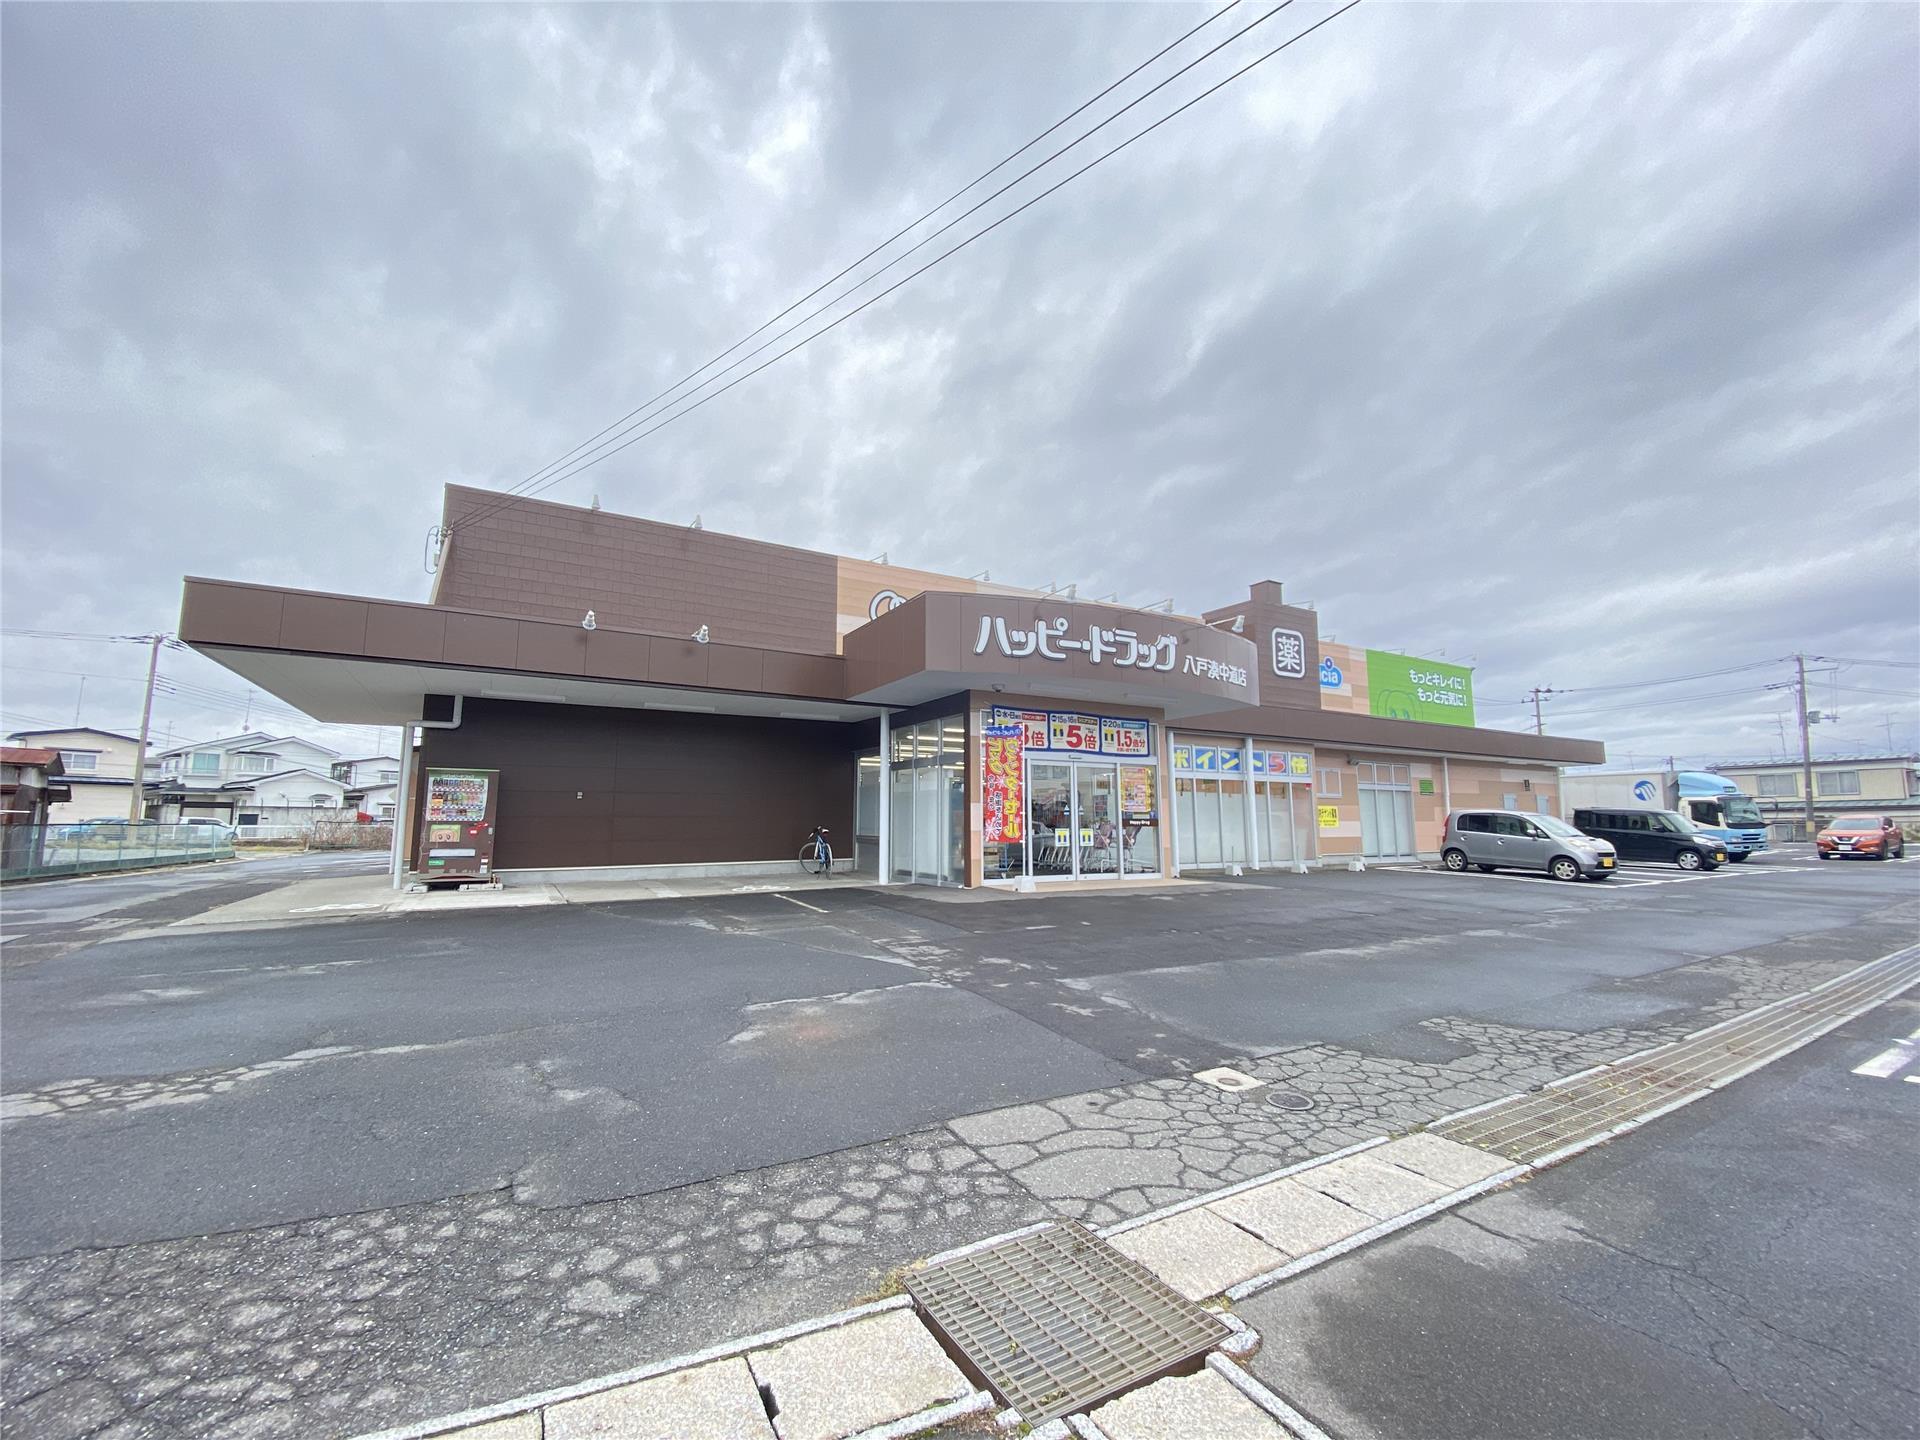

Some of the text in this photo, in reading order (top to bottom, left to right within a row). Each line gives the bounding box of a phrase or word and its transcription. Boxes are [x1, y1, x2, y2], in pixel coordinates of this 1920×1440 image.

[1277, 635, 1301, 671] 薬
[1182, 655, 1248, 688] 八戸湊中道店
